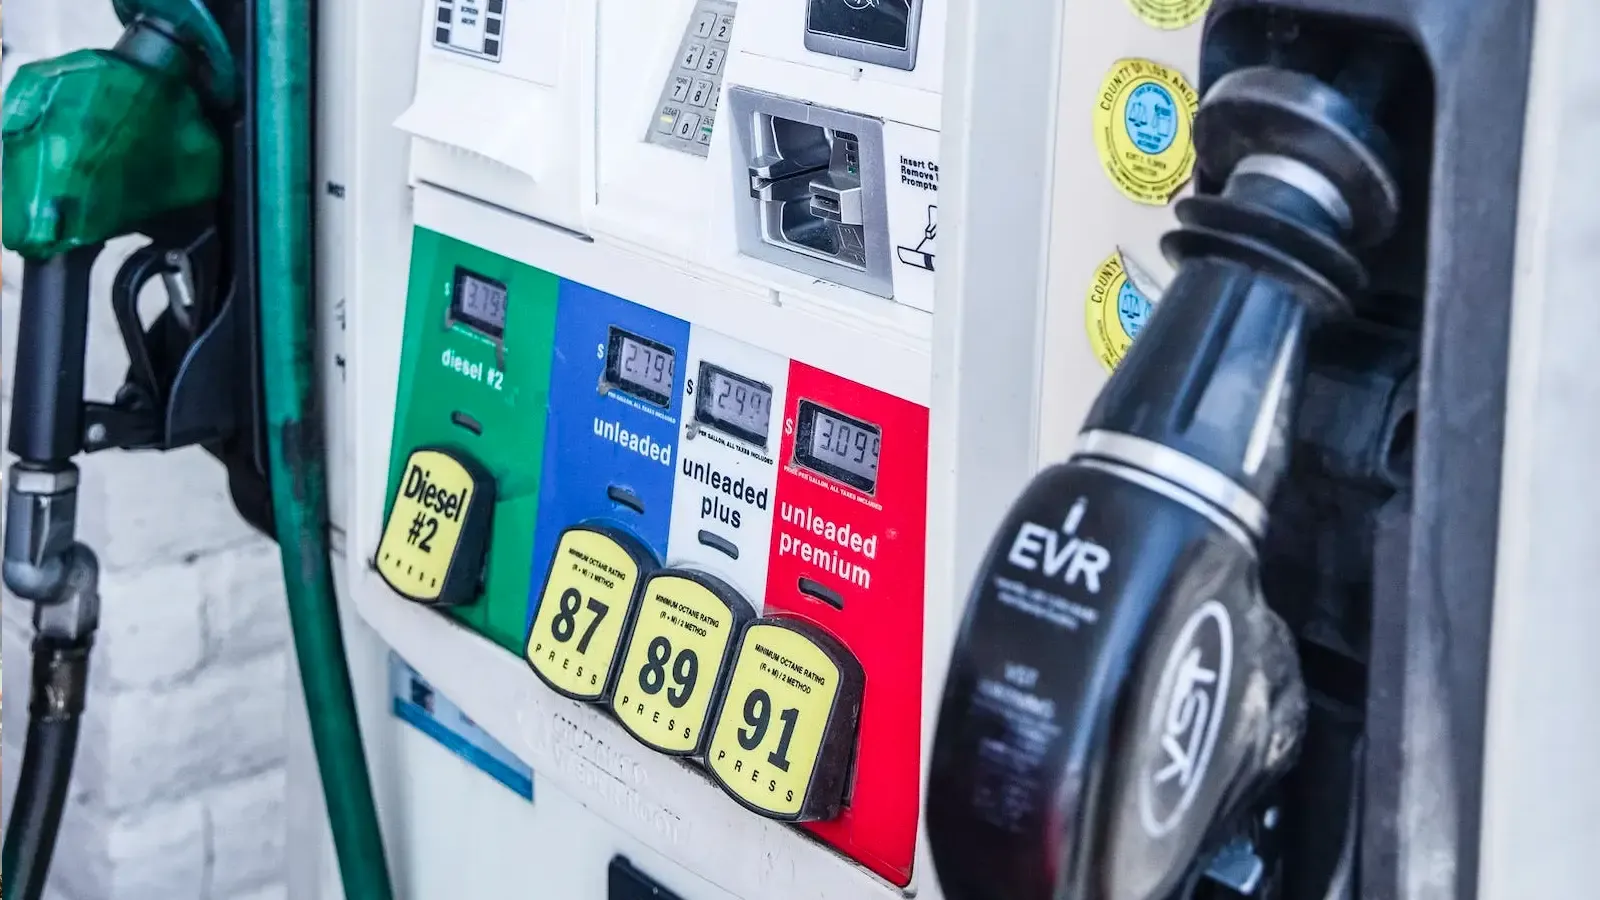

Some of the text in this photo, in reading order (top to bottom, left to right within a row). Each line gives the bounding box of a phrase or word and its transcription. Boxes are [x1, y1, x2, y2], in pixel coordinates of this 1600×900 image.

[699, 22, 705, 33] 1
[718, 26, 726, 37] 2
[686, 54, 693, 64] 4
[706, 58, 714, 70] 5
[674, 86, 681, 97] 7
[694, 90, 702, 102] 8
[1100, 66, 1131, 111] COUNTY
[681, 123, 689, 135] 0
[900, 155, 925, 169] Insert
[901, 165, 933, 181] Remove
[1091, 258, 1121, 304] COUNTY
[441, 348, 504, 391] diesel #2
[686, 379, 694, 396] $
[593, 417, 672, 467] unleaded
[785, 417, 794, 435] $
[726, 441, 736, 450] ALL
[751, 451, 774, 466] INCLUDED
[404, 464, 468, 523] Diesel
[683, 458, 769, 511] unleaded
[830, 485, 841, 494] ALL
[840, 489, 857, 501] TAXES
[856, 496, 884, 512] INCLUDED
[701, 496, 741, 529] plus
[407, 511, 439, 553] #2
[781, 501, 877, 560] unleaded
[589, 557, 609, 572] OCTANE
[608, 566, 626, 581] RATING
[779, 531, 872, 590] premium
[1007, 520, 1111, 594] EVR
[594, 574, 614, 589] METHOD
[551, 587, 610, 655] 87
[655, 593, 720, 628] MINIMUM OCTANE RATING
[685, 621, 707, 638] METHOD
[535, 643, 598, 685] PRESS
[638, 635, 700, 709] 89
[754, 643, 826, 686] MINIMUM OCTANE RATING
[786, 675, 812, 694] METHOD
[622, 695, 692, 740] PRESS
[737, 688, 800, 773] 91
[717, 750, 794, 802] PRESS
